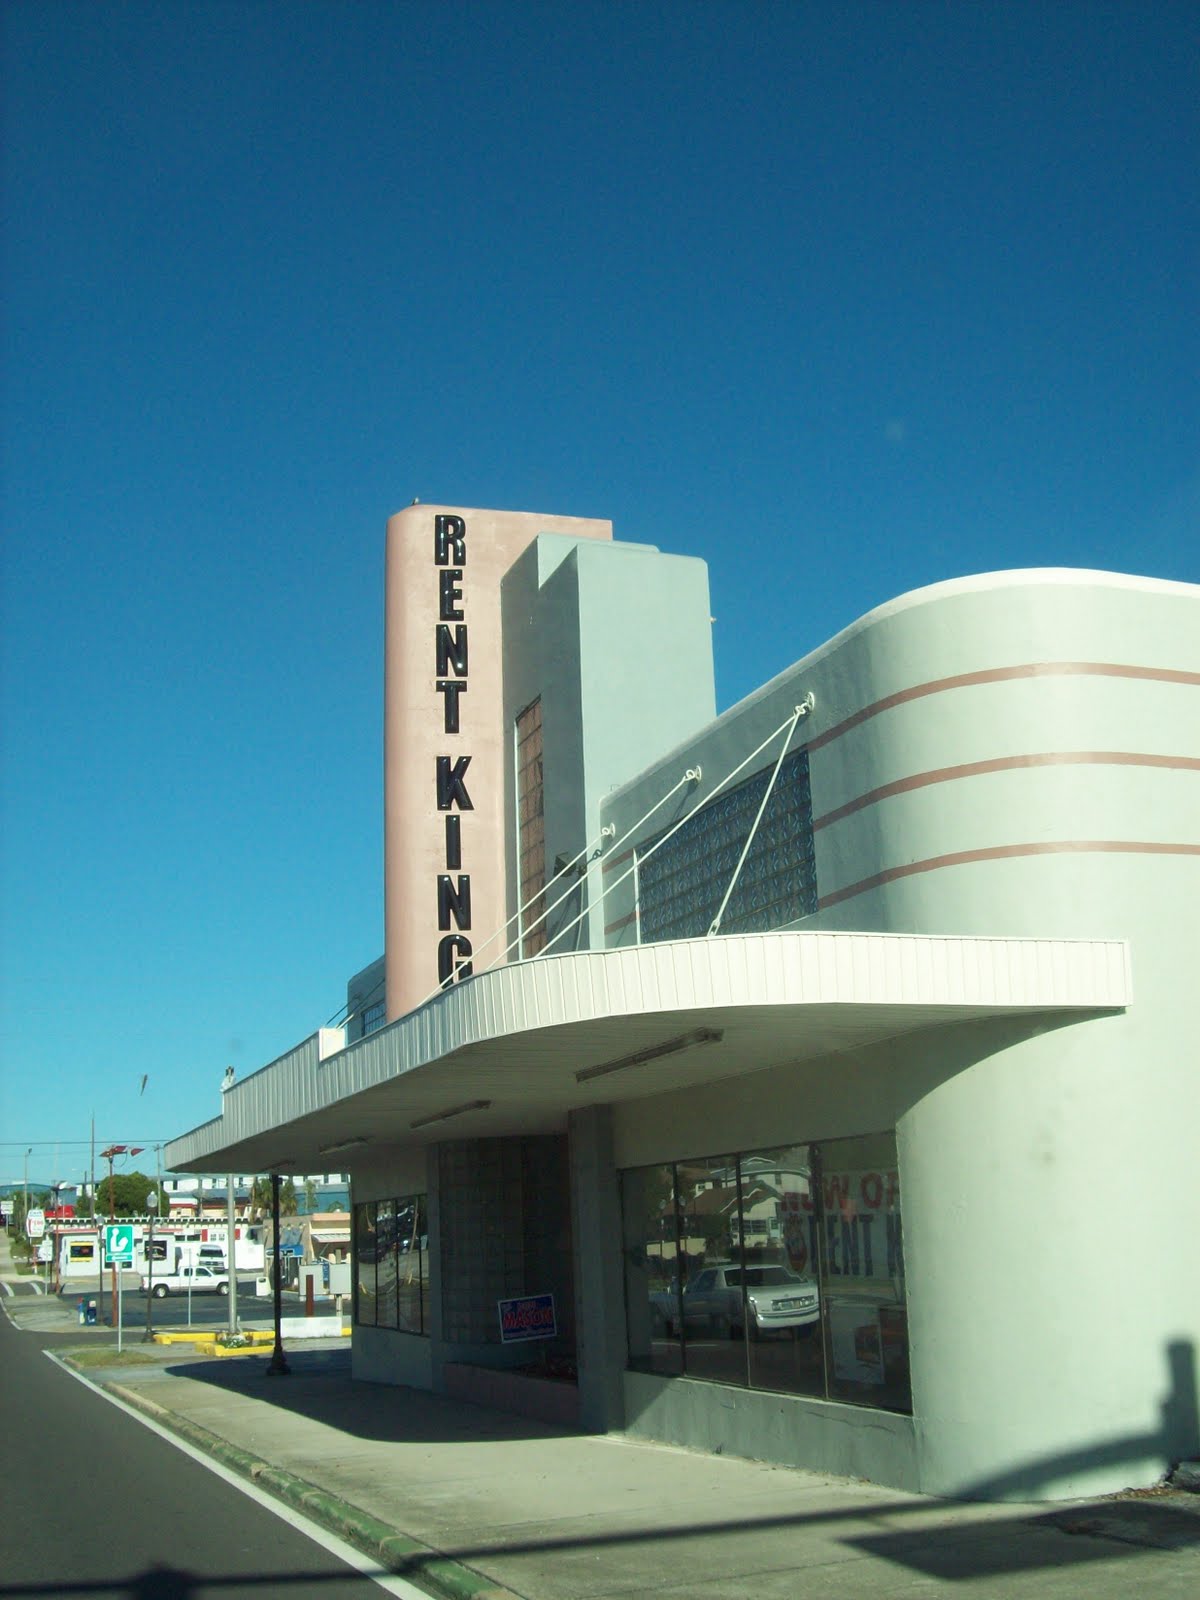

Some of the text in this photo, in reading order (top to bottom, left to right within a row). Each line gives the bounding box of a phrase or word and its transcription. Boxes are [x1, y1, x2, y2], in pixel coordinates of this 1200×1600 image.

[434, 514, 475, 990] RENT KING
[503, 1308, 552, 1329] MASON
